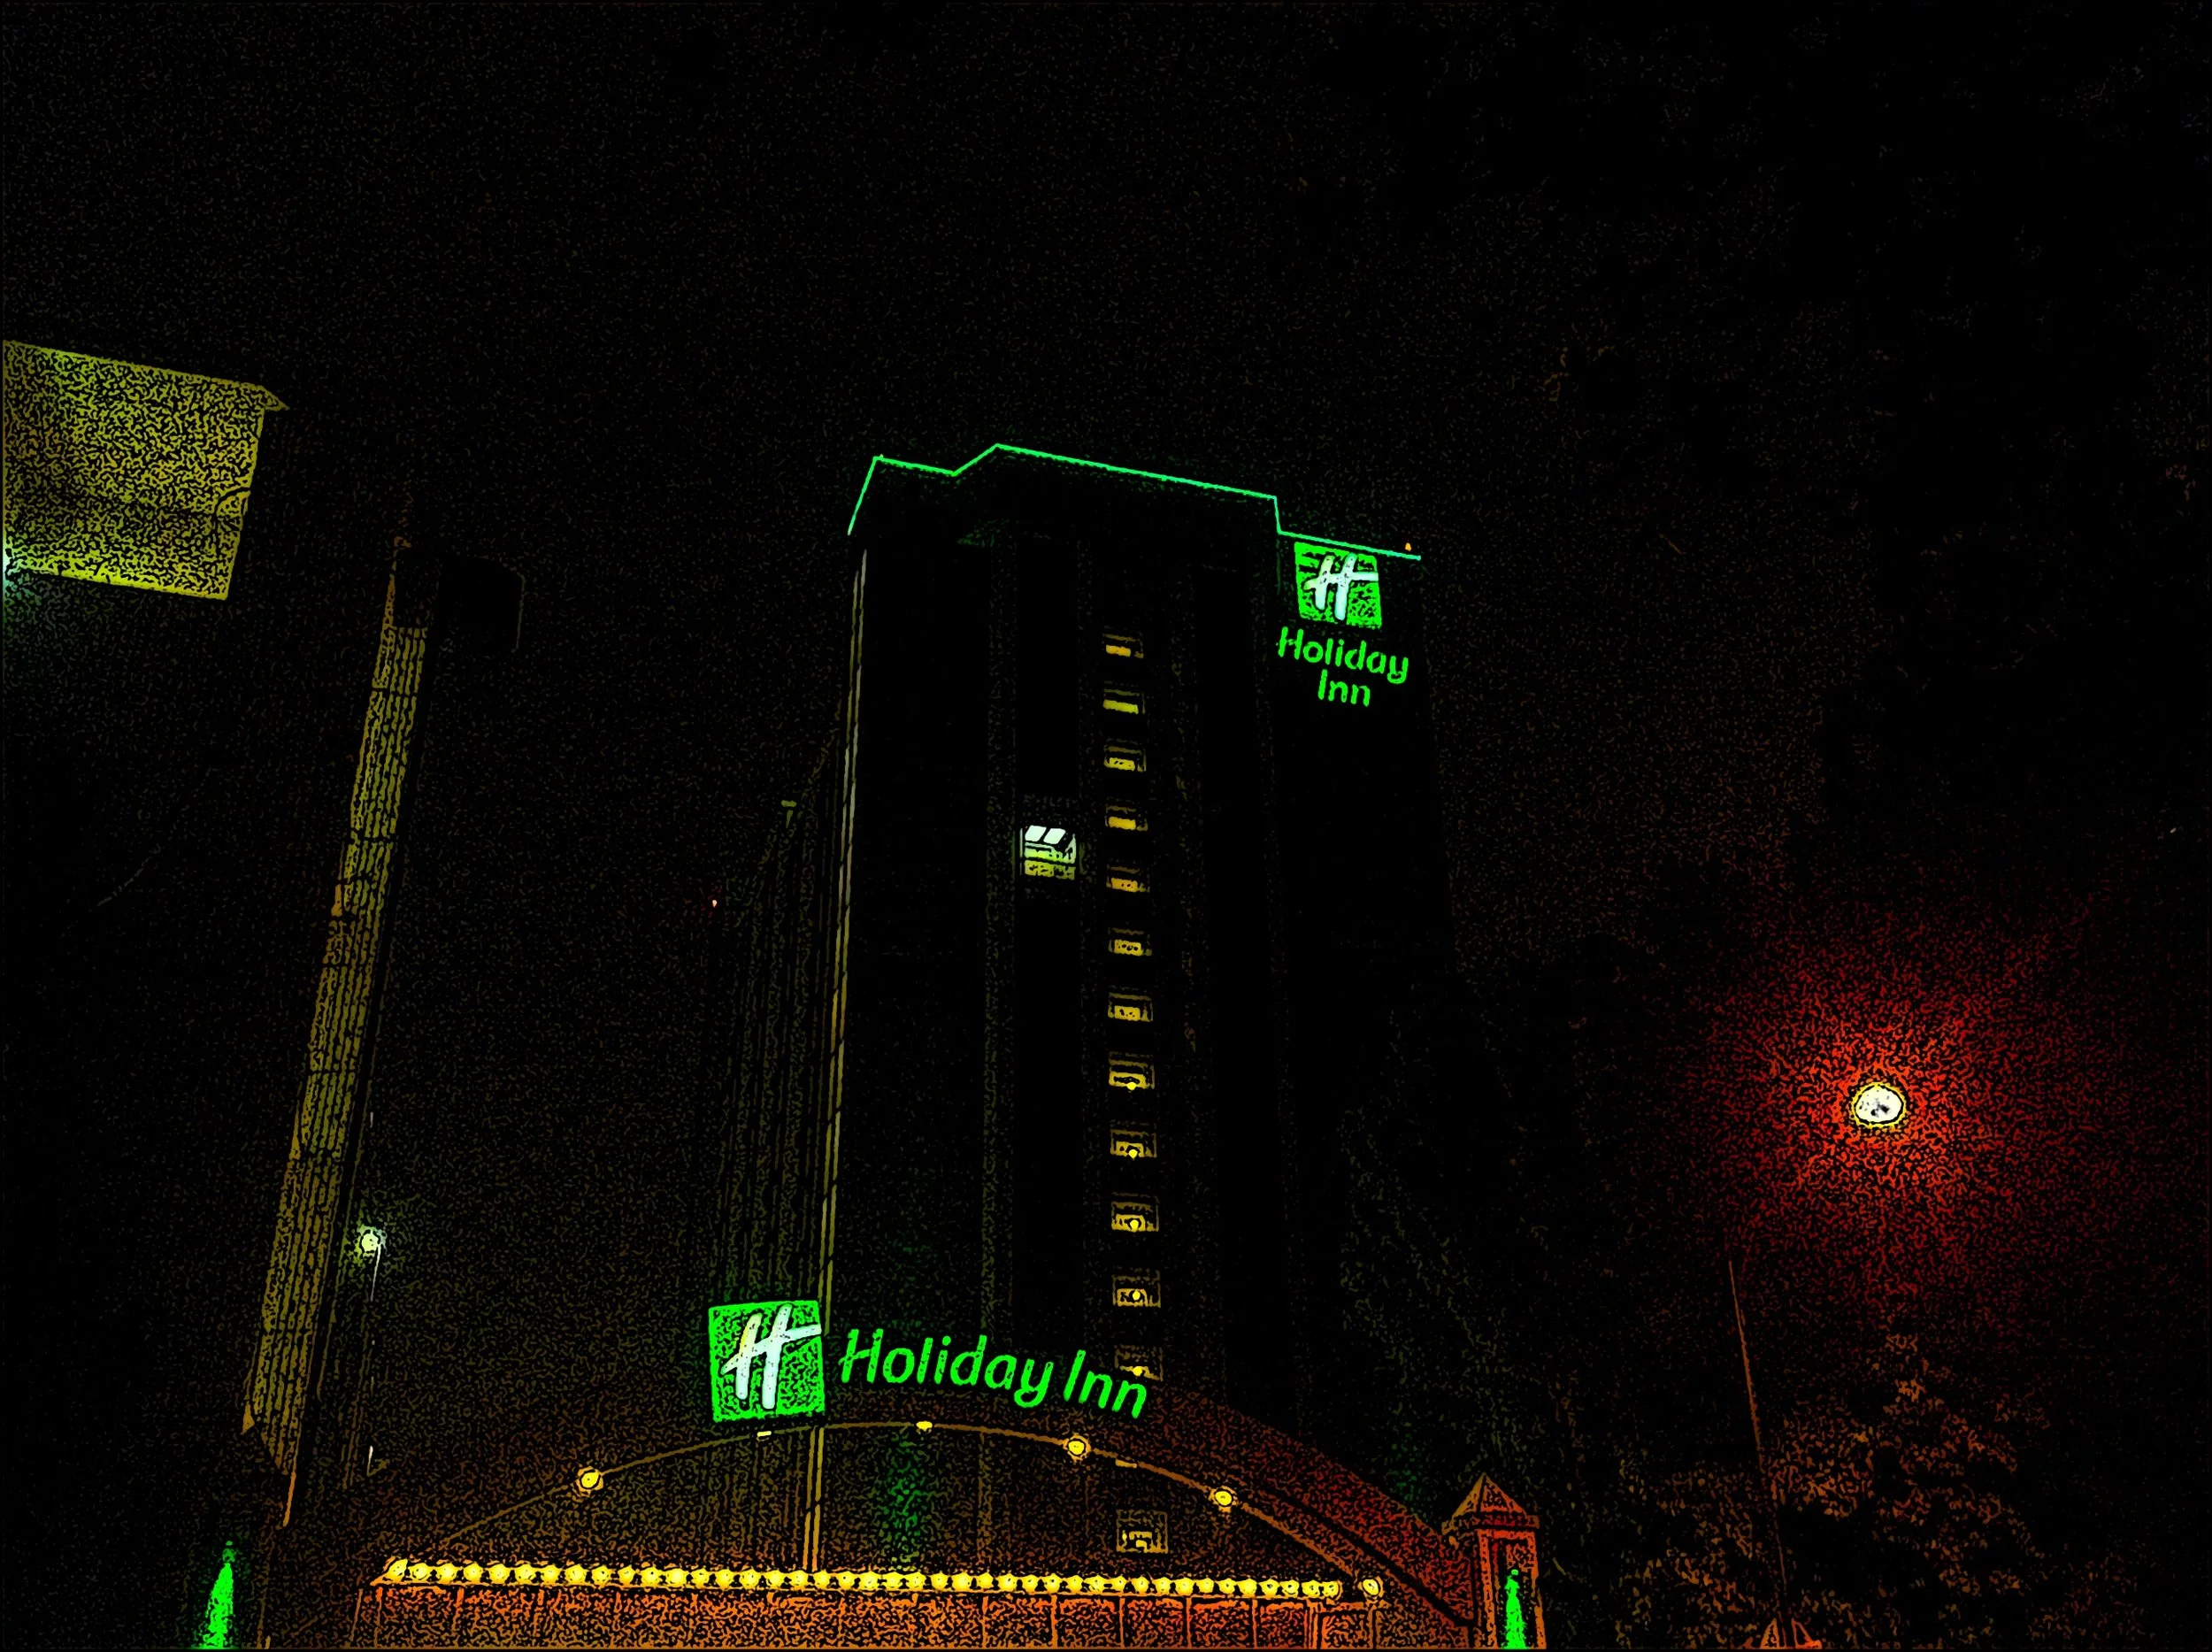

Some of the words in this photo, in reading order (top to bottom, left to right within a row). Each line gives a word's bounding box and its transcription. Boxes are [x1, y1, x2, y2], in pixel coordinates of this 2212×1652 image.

[1278, 626, 1409, 684] Holiday
[1317, 669, 1371, 707] Inn
[838, 1328, 1055, 1409] Holiday
[1063, 1349, 1148, 1419] Inn
